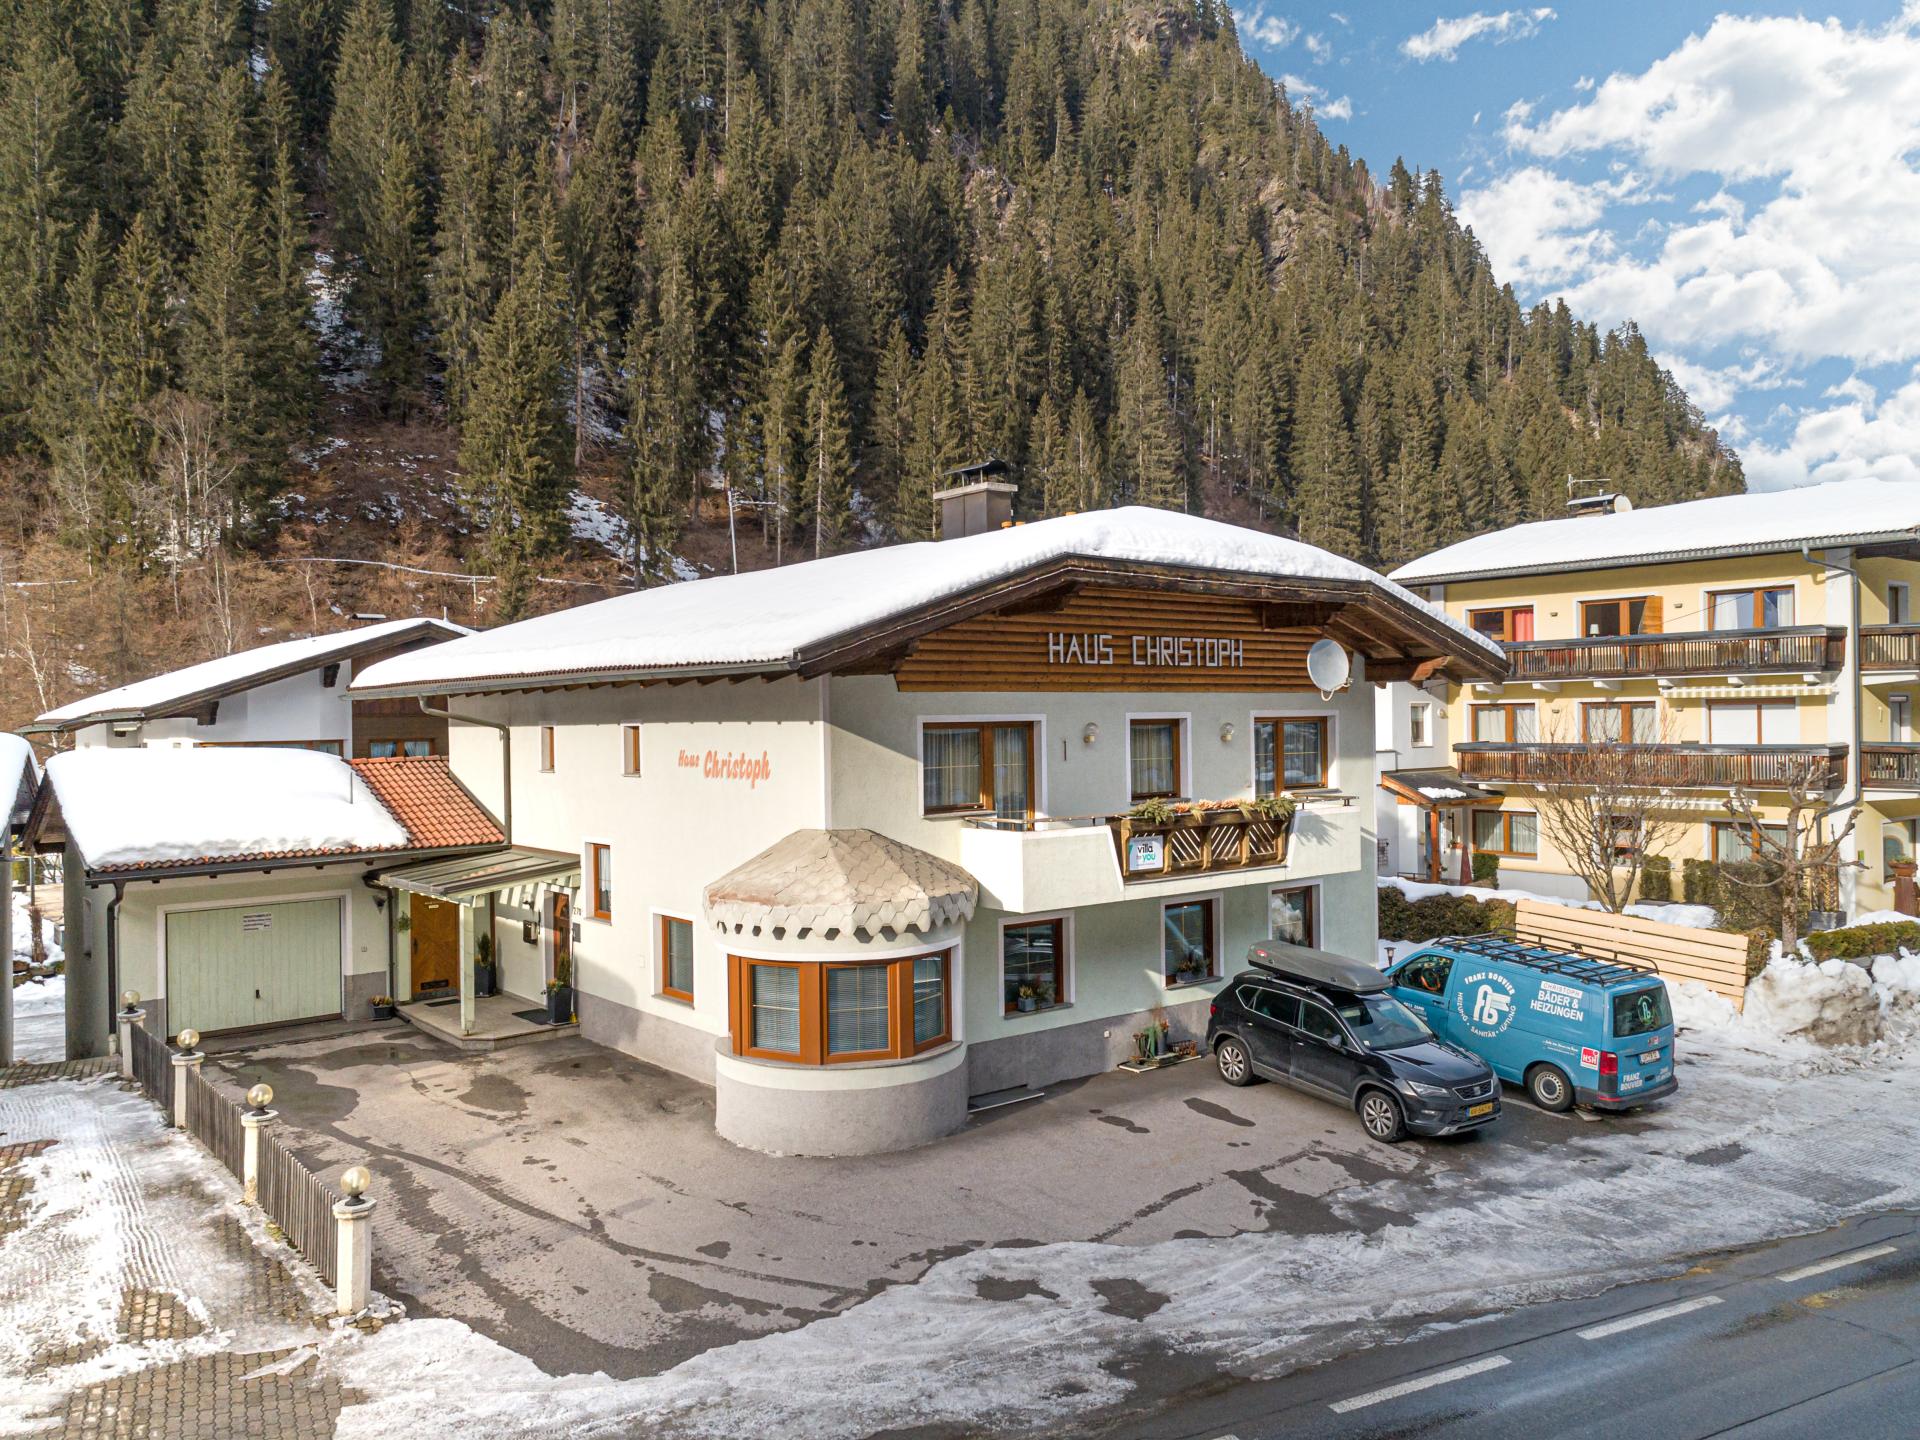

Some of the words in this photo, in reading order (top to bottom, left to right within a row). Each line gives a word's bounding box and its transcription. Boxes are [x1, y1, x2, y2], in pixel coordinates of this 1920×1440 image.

[1048, 632, 1113, 665] HAUS
[1131, 635, 1243, 667] CHRISTOPH
[678, 749, 699, 767] Haus
[703, 750, 770, 789] Christoph
[1137, 843, 1154, 853] villa
[1464, 972, 1487, 985] FRANZ
[1488, 972, 1516, 995] BOUVIER
[1530, 999, 1584, 1022] HEIZUNGEN
[1538, 990, 1571, 1007] BÄDER
[1571, 998, 1579, 1009] &
